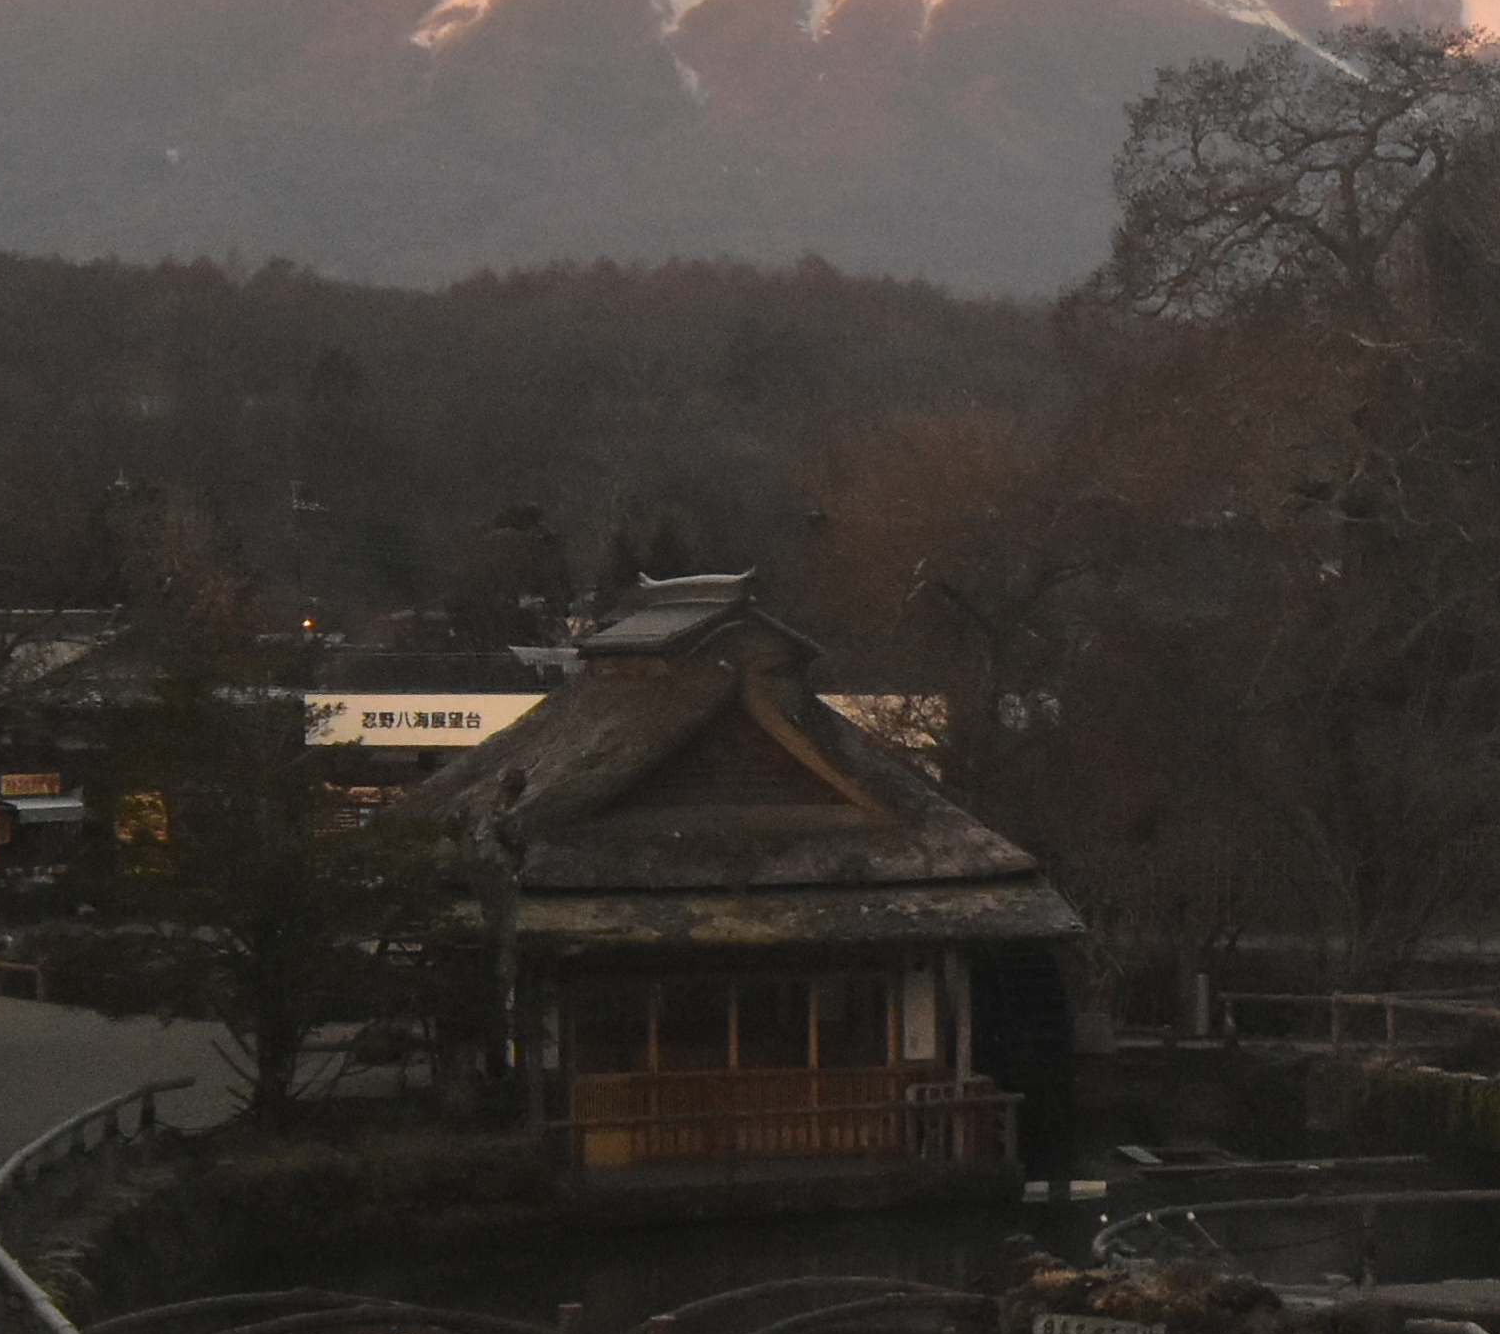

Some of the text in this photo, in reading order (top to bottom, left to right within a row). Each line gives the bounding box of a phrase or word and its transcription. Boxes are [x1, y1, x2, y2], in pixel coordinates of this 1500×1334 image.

[361, 711, 482, 729] 忍野八海展望台
